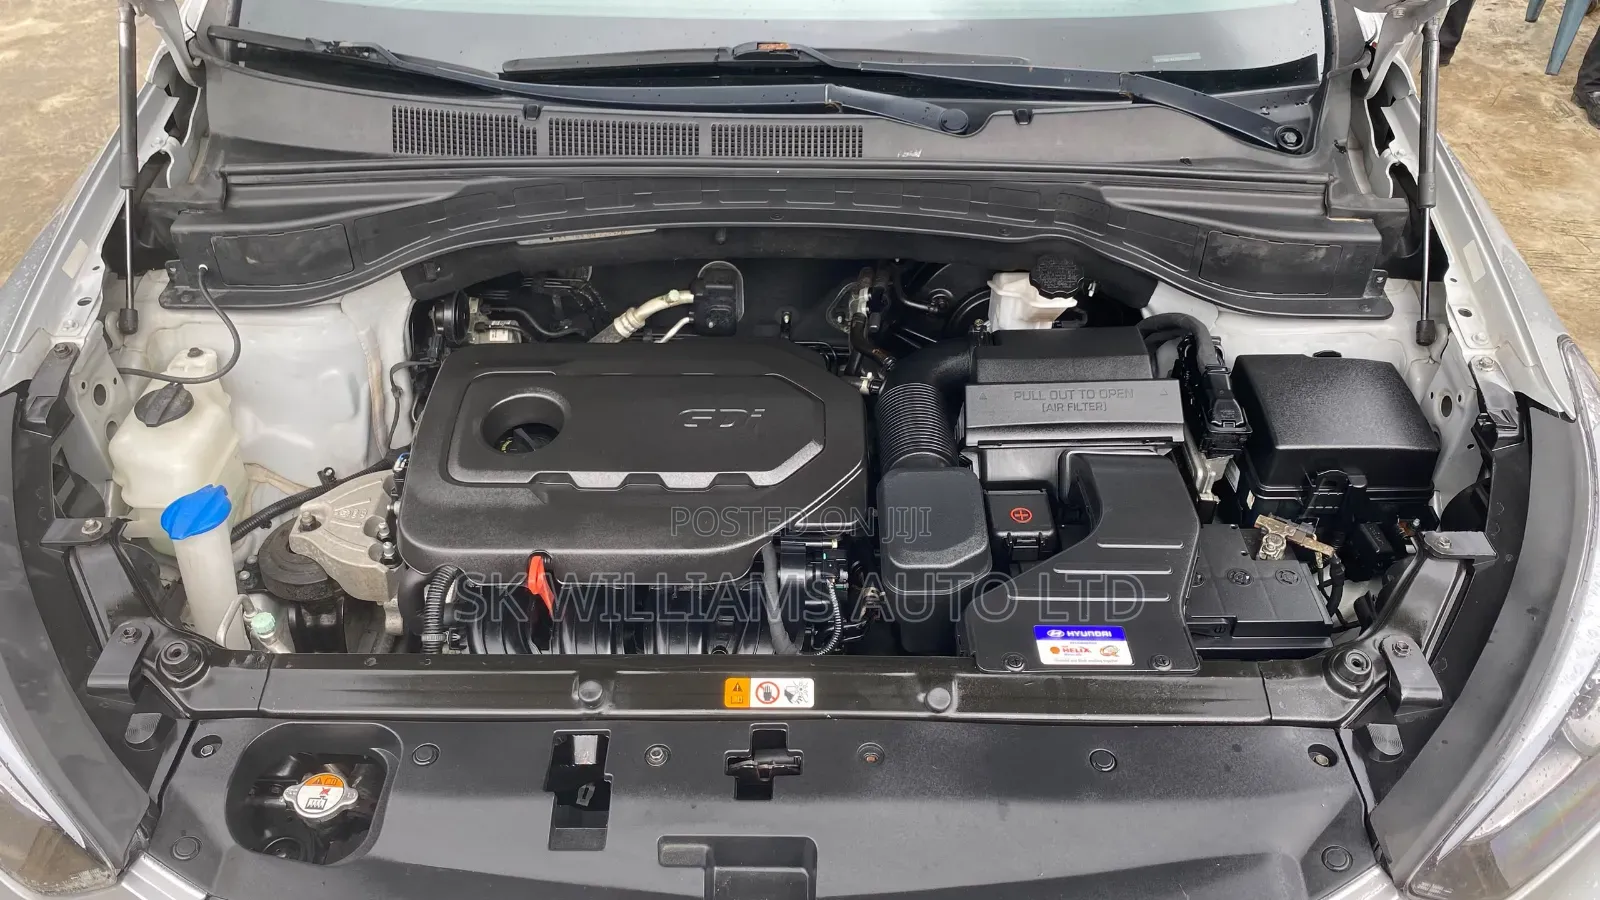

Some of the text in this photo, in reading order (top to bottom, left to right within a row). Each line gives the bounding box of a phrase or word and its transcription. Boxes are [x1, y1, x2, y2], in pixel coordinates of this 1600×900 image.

[1013, 388, 1134, 401] PULL OUT TO OPEN
